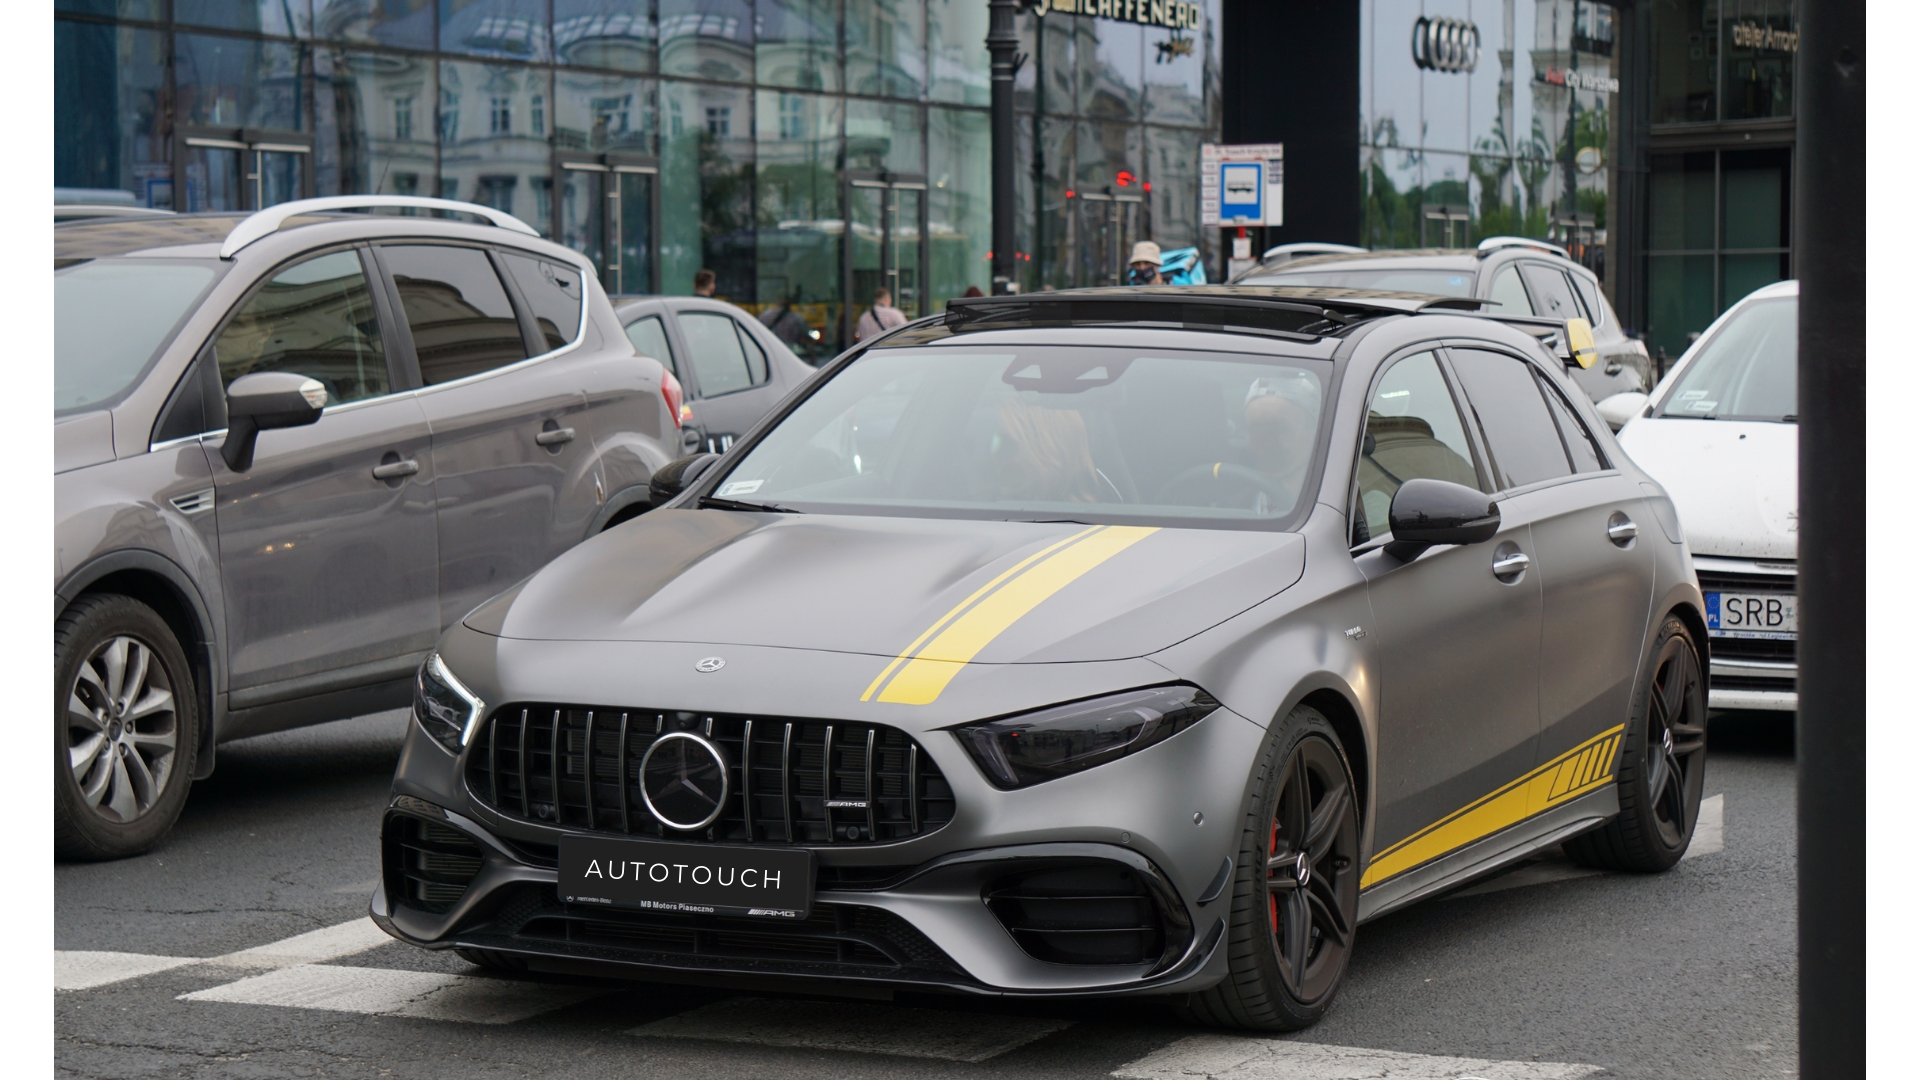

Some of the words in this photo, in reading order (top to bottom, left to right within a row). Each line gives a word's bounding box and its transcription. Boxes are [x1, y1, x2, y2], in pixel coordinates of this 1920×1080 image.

[1726, 598, 1783, 626] SRB
[1708, 613, 1719, 623] PL
[641, 900, 652, 908] MB
[653, 902, 677, 910] Motors
[679, 904, 714, 913] Piaseczno
[764, 909, 796, 917] AMG
